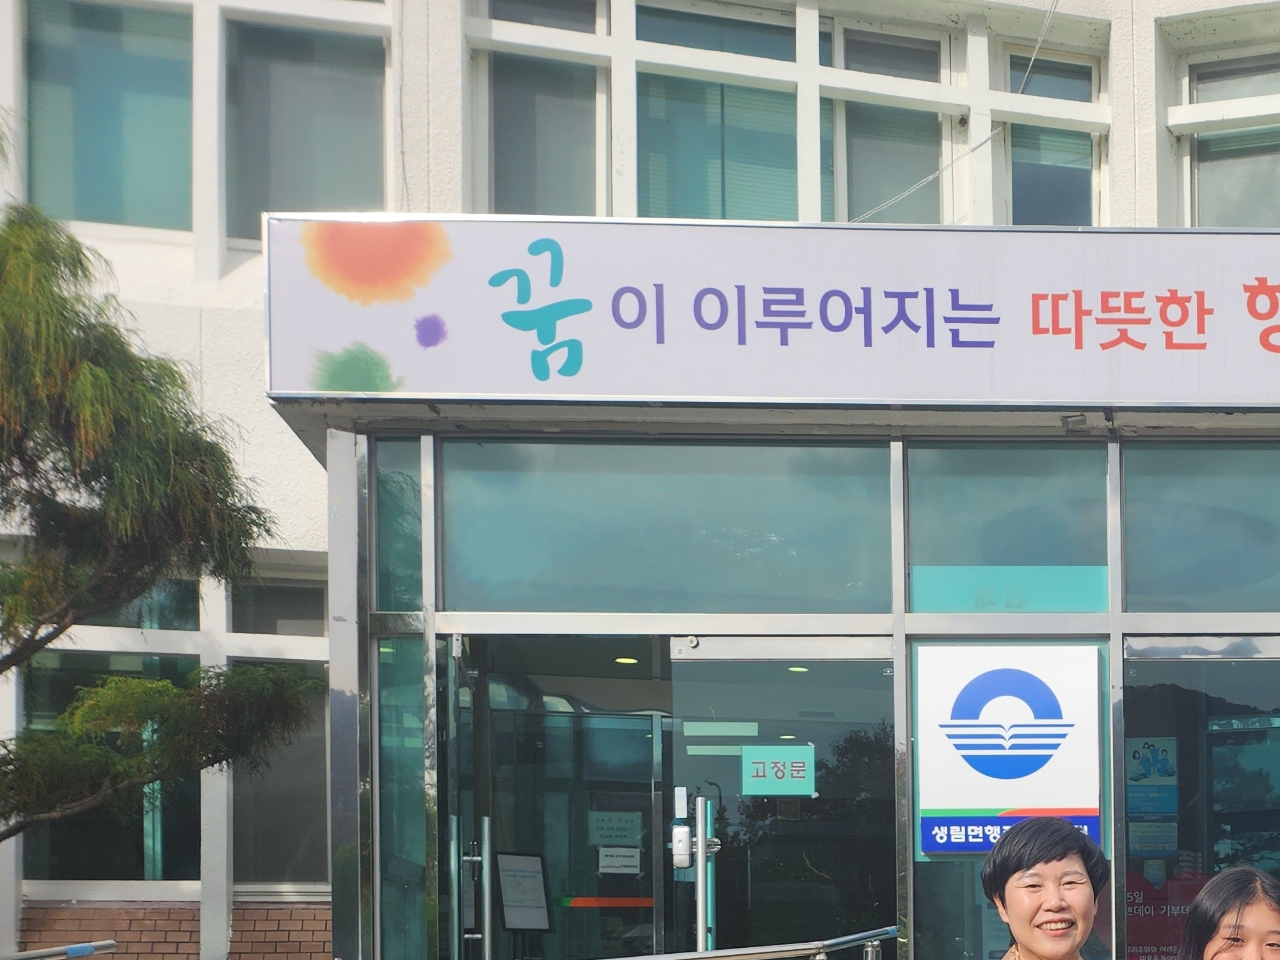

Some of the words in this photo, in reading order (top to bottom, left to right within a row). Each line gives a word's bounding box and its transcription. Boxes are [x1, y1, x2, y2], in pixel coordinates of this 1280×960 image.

[692, 283, 1001, 349] 이루어지는
[1030, 288, 1214, 351] 따뜻한
[750, 761, 807, 780] 고정문
